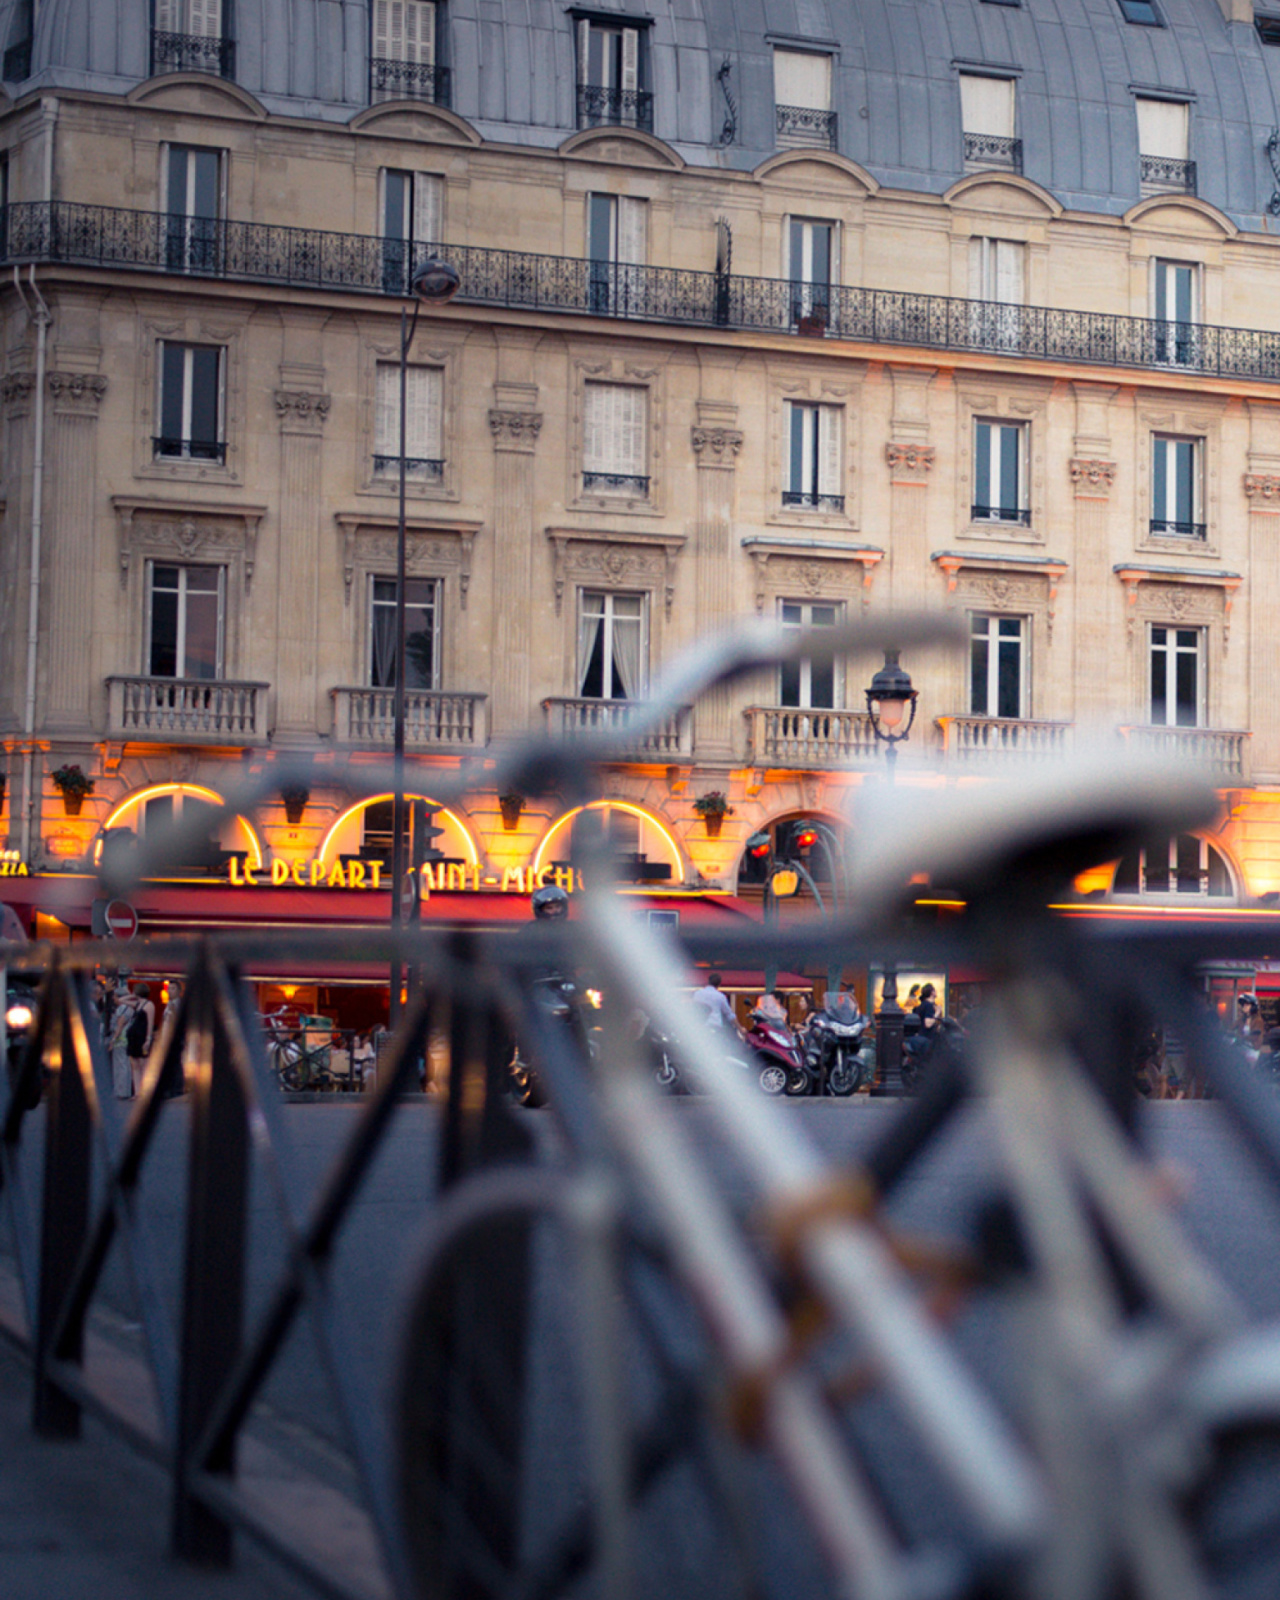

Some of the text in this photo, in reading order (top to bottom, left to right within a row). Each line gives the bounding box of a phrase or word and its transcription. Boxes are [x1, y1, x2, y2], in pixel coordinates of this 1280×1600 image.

[229, 856, 586, 893] LE DEPART AINT-MICH
